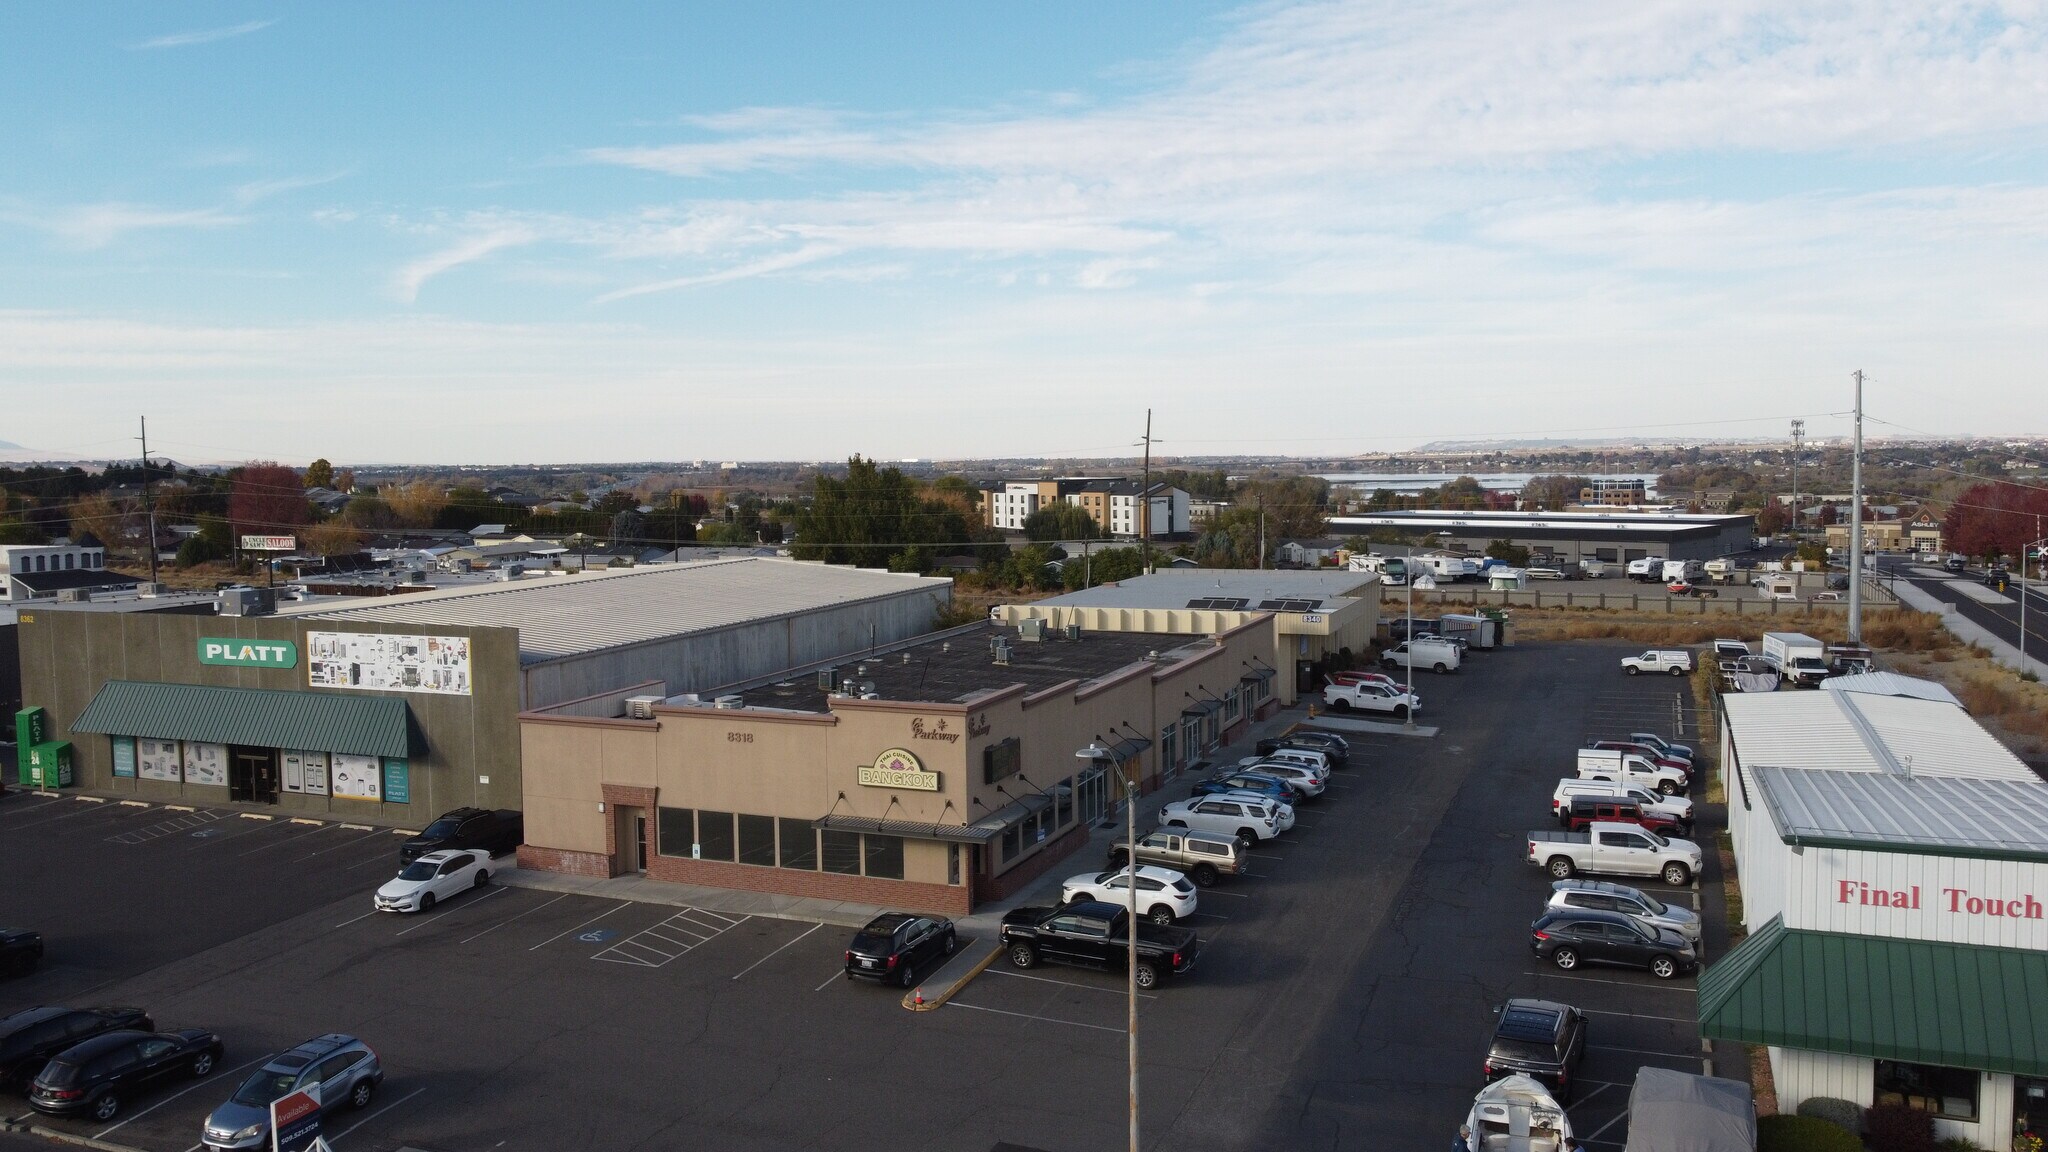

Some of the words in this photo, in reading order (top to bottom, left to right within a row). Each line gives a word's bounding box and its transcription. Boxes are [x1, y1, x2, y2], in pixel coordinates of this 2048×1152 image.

[267, 538, 294, 548] SALOON
[1303, 615, 1321, 623] 8340
[206, 643, 287, 662] PLATT
[32, 714, 41, 742] PLATT
[912, 728, 960, 744] Parkway
[727, 731, 754, 743] 8318
[879, 753, 892, 764] THAI
[892, 752, 914, 765] CUISINE
[860, 769, 935, 788] BANGKOK
[1837, 879, 1920, 910] Final
[1943, 887, 2044, 920] Touch
[277, 1102, 310, 1123] Available
